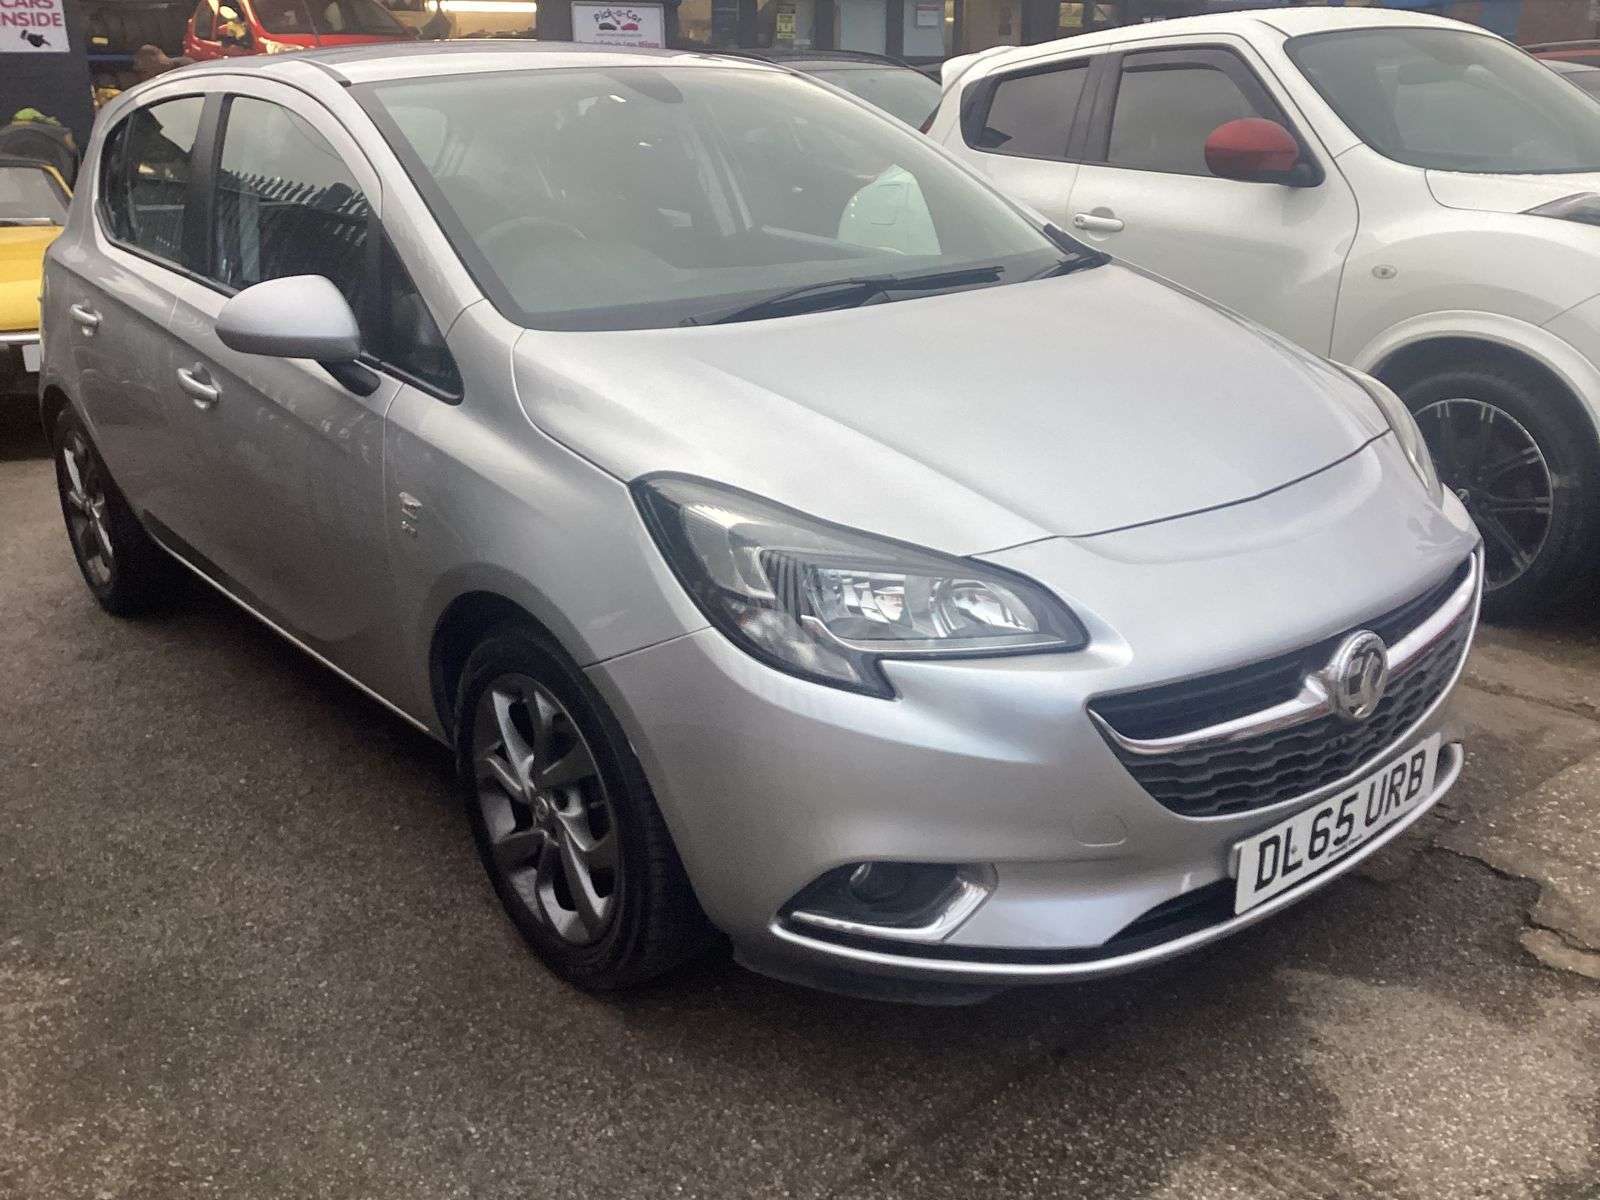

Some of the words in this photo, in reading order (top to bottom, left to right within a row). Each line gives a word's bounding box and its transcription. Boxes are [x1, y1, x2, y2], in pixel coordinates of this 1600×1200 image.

[0, 12, 63, 27] NSIDE
[1254, 792, 1360, 893] DL65
[1364, 749, 1426, 828] URB
